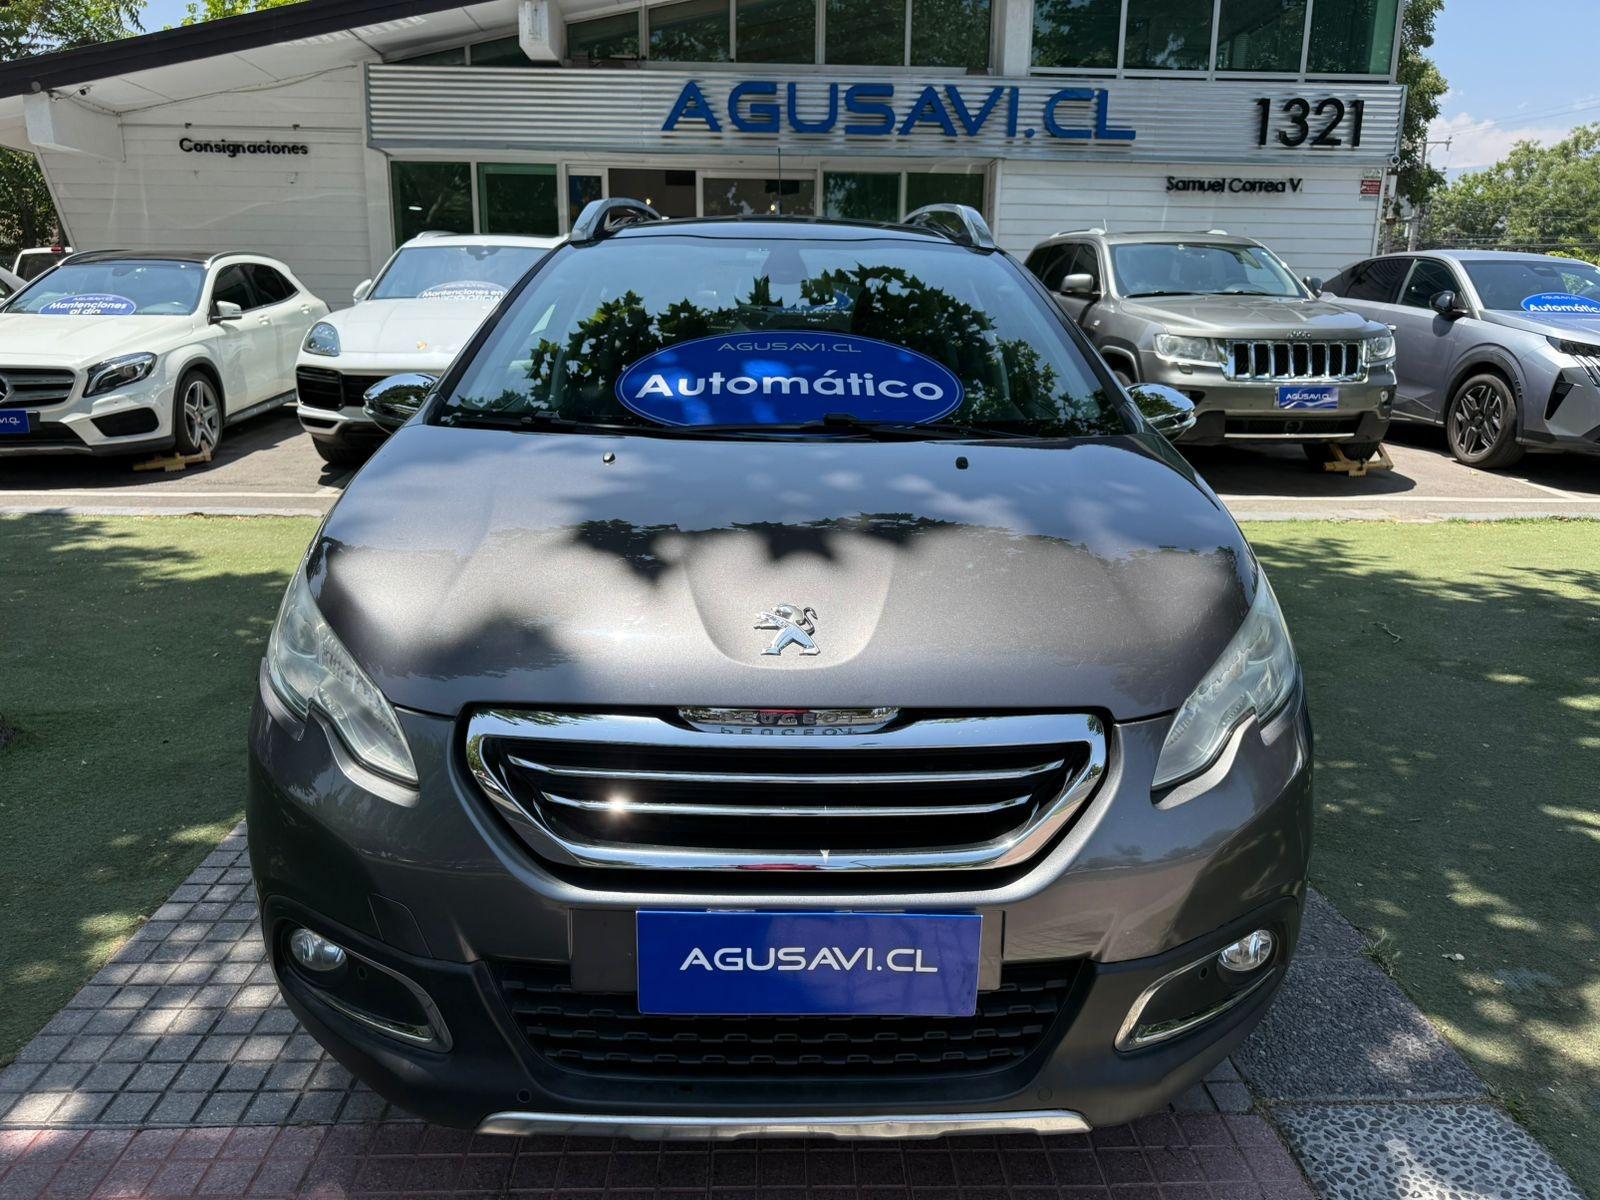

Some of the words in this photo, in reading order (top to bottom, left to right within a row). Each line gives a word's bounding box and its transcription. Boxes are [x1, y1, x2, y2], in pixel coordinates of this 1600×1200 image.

[660, 79, 1137, 141] AGUSAVI.CL
[1256, 97, 1365, 147] 1321
[179, 137, 308, 158] Consignaciones
[1166, 176, 1226, 193] Samuel
[1229, 178, 1286, 193] Correa
[49, 301, 128, 310] Mantenciones
[1529, 303, 1600, 313] Automátic
[718, 342, 861, 353] AGUSAVI.CL
[635, 369, 944, 401] Automático
[679, 947, 938, 972] AGUSAVI.CL
